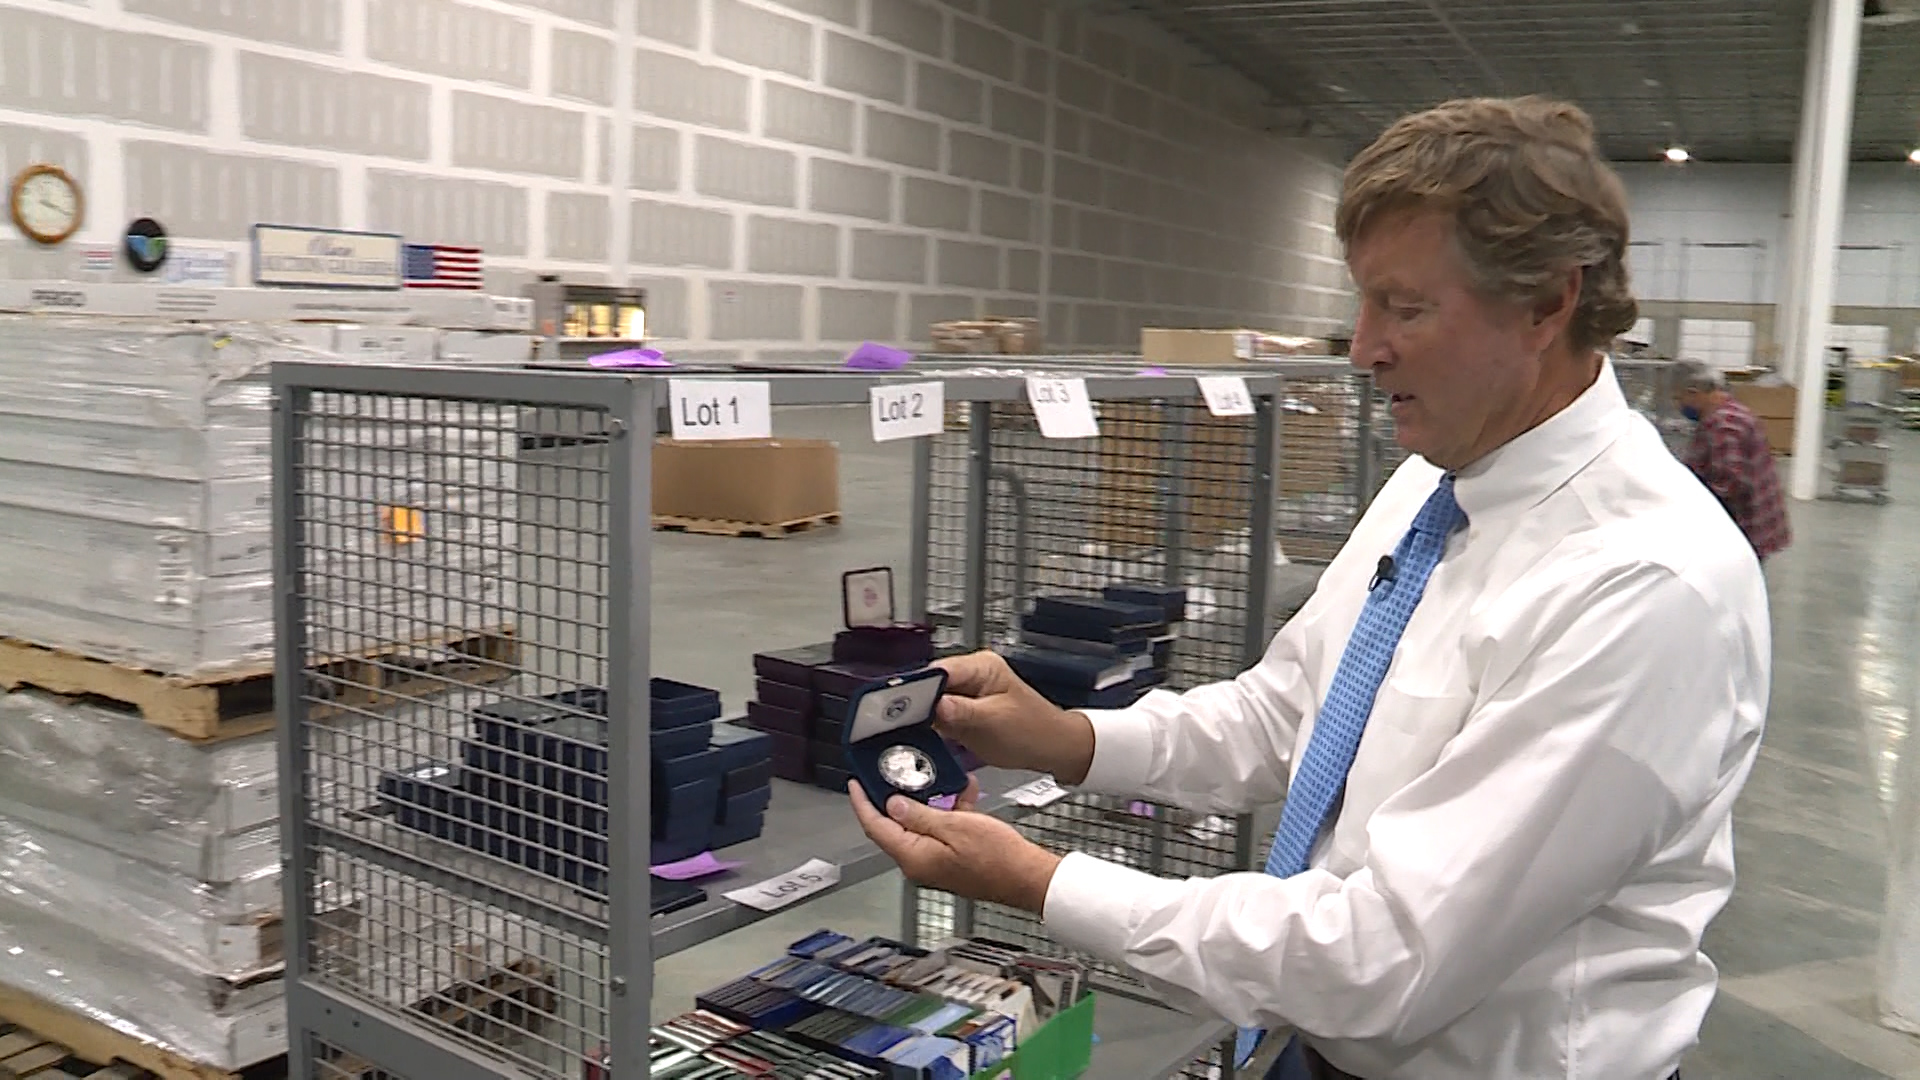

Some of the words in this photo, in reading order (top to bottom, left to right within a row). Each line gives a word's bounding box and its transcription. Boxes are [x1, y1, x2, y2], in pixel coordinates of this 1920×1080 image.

[1054, 381, 1071, 404] 3
[681, 397, 721, 426] Lot
[728, 395, 740, 424] 1
[878, 395, 907, 422] Lot
[911, 392, 924, 418] 2
[759, 881, 808, 899] Lot
[797, 873, 823, 882] 5
